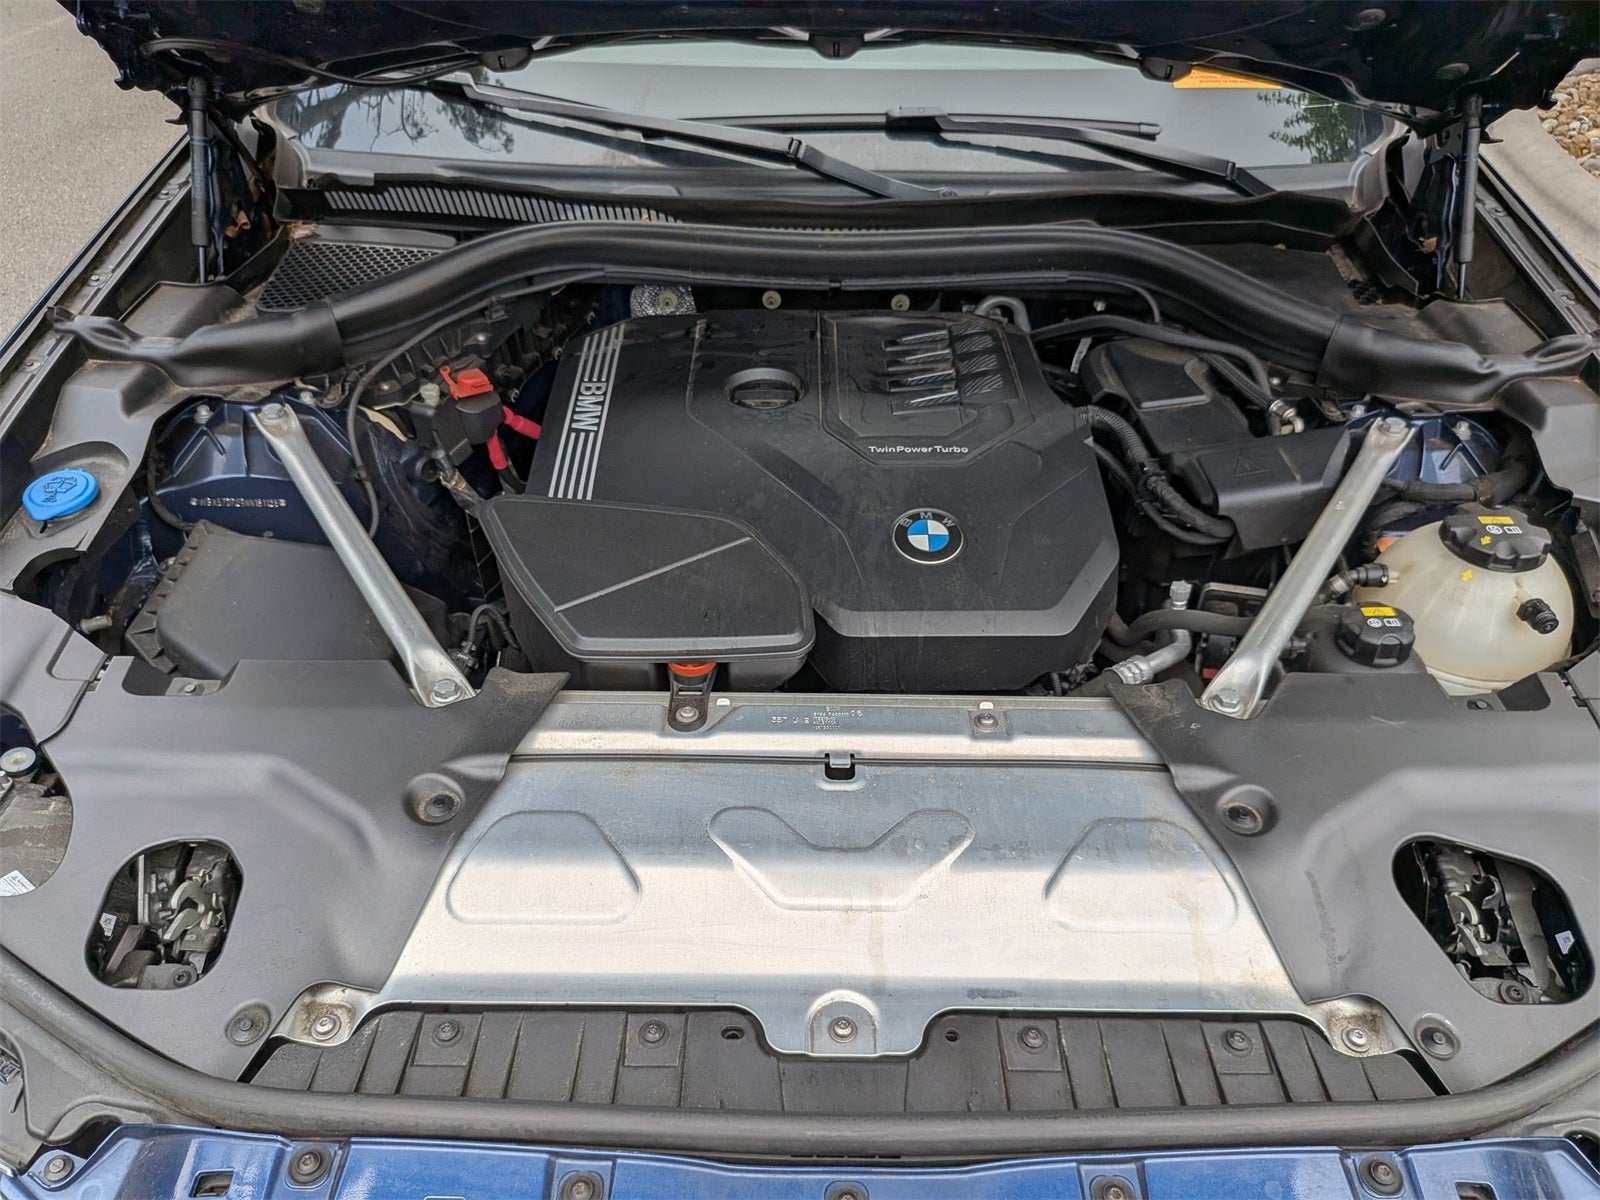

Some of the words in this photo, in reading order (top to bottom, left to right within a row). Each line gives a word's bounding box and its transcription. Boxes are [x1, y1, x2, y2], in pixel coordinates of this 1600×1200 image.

[571, 382, 607, 431] BMW
[868, 445, 933, 454] TwinPower
[934, 445, 969, 454] Turbo
[900, 511, 956, 528] BMW
